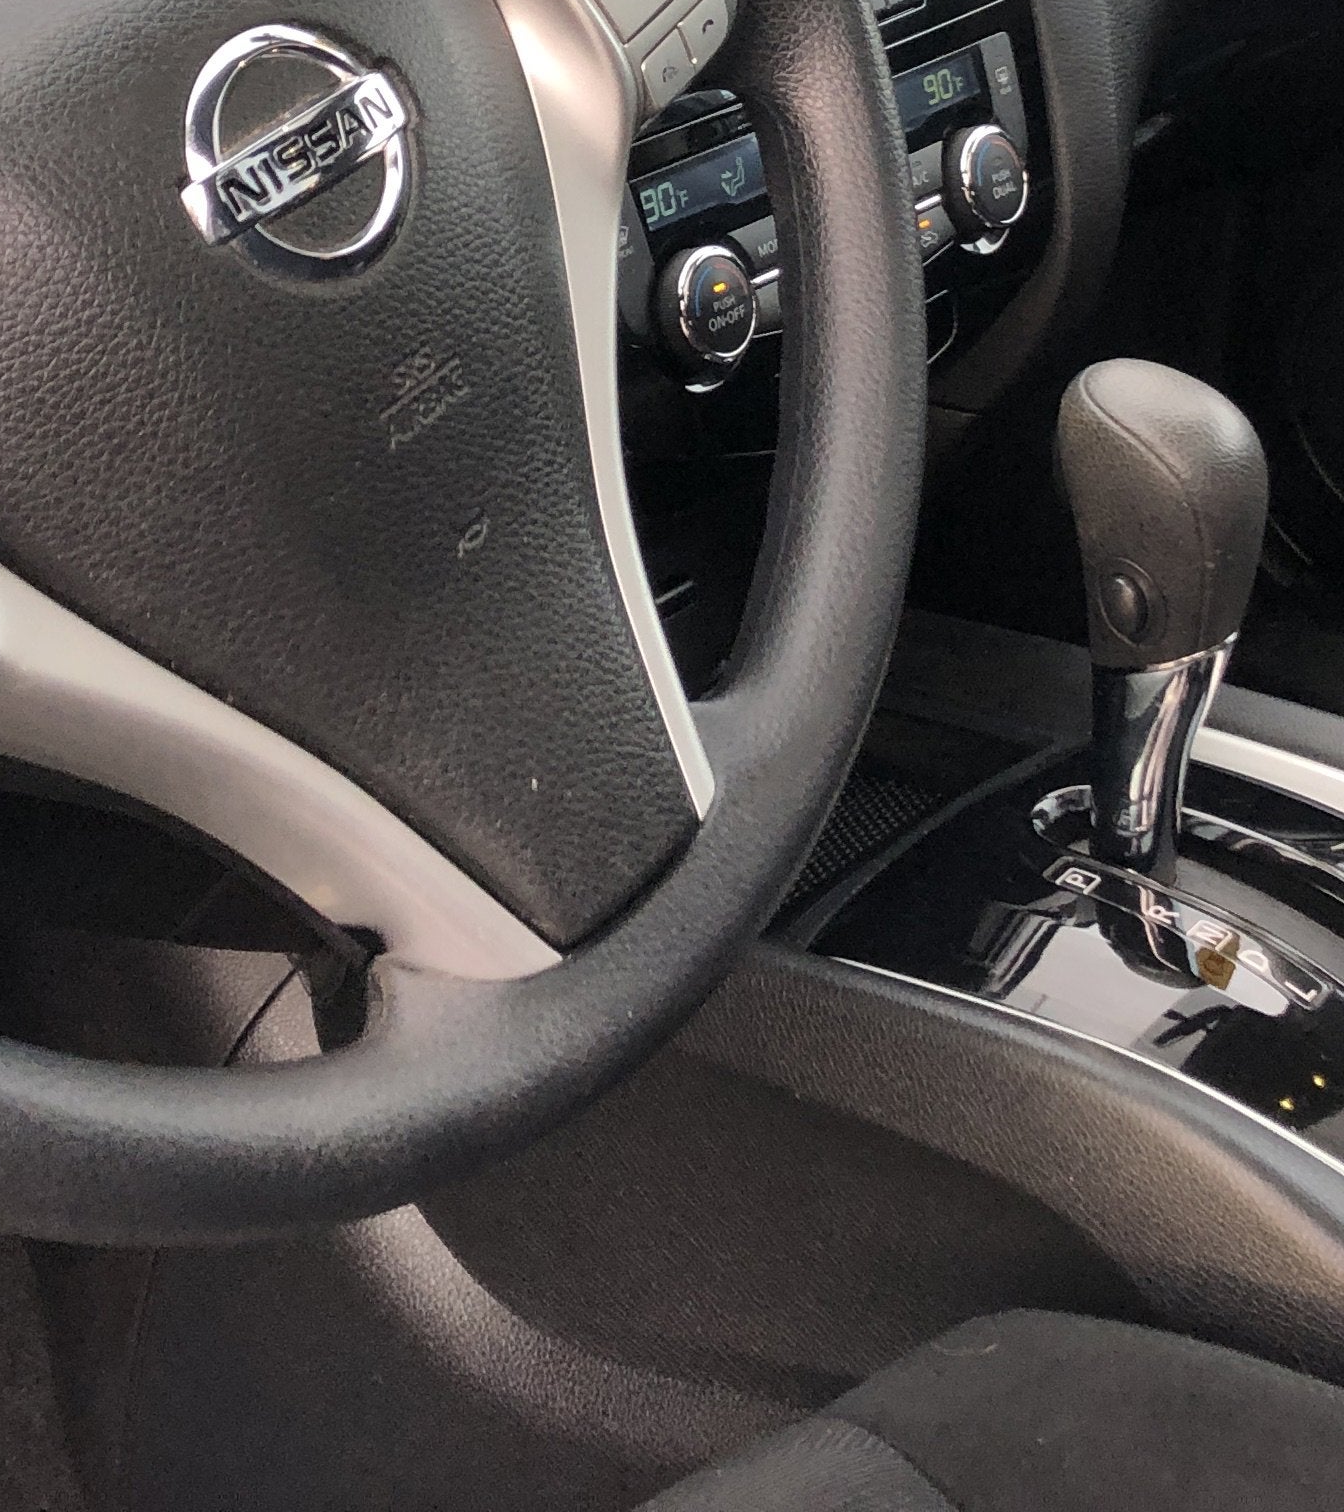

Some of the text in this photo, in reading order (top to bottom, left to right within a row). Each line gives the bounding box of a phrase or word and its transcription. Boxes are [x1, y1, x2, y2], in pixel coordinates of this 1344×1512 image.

[220, 87, 394, 224] NISSAN
[712, 293, 736, 312] PUSH
[1148, 905, 1180, 925] R
[1236, 949, 1270, 973] D
[1284, 980, 1318, 1002] L
